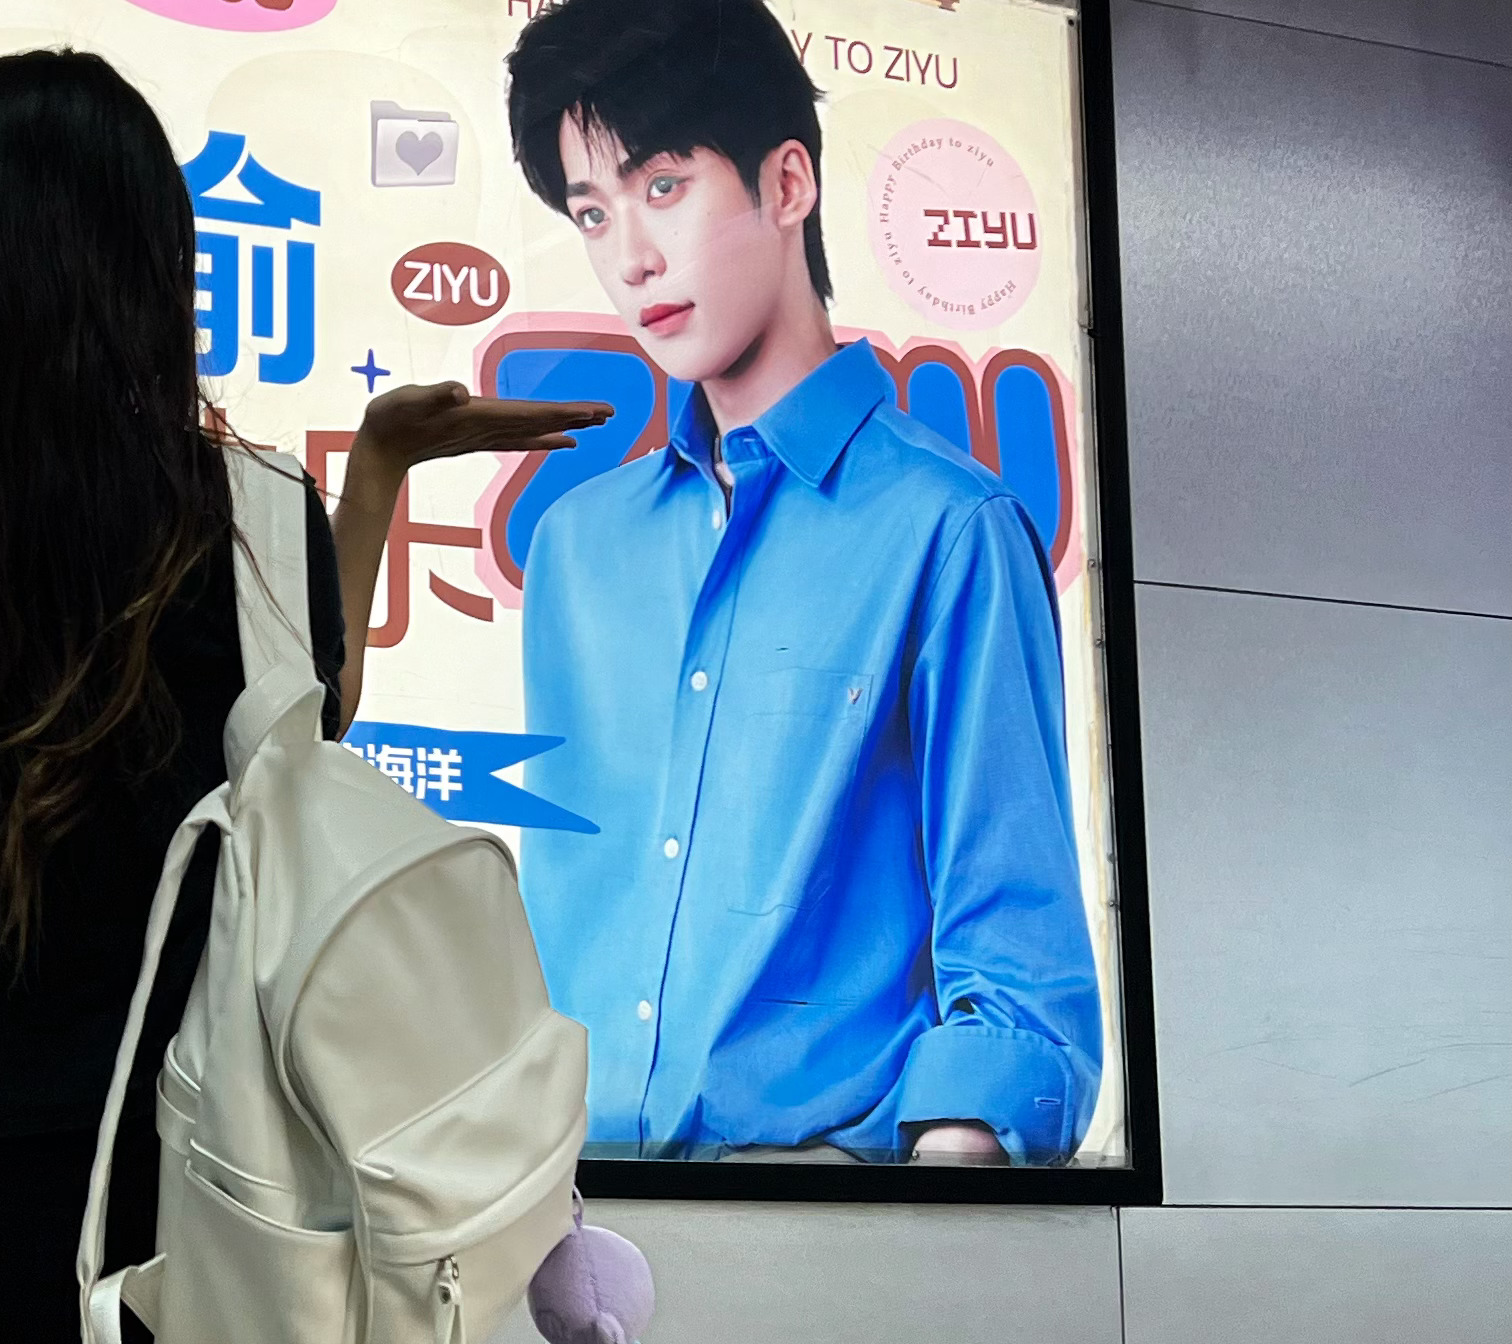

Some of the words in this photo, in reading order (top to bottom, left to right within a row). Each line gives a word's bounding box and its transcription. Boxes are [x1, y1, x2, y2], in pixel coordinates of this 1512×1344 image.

[825, 35, 873, 75] TO
[883, 45, 959, 89] ZIYU
[922, 208, 1038, 250] ZIYU
[403, 260, 499, 307] ZIYU
[343, 741, 463, 801] 海洋
